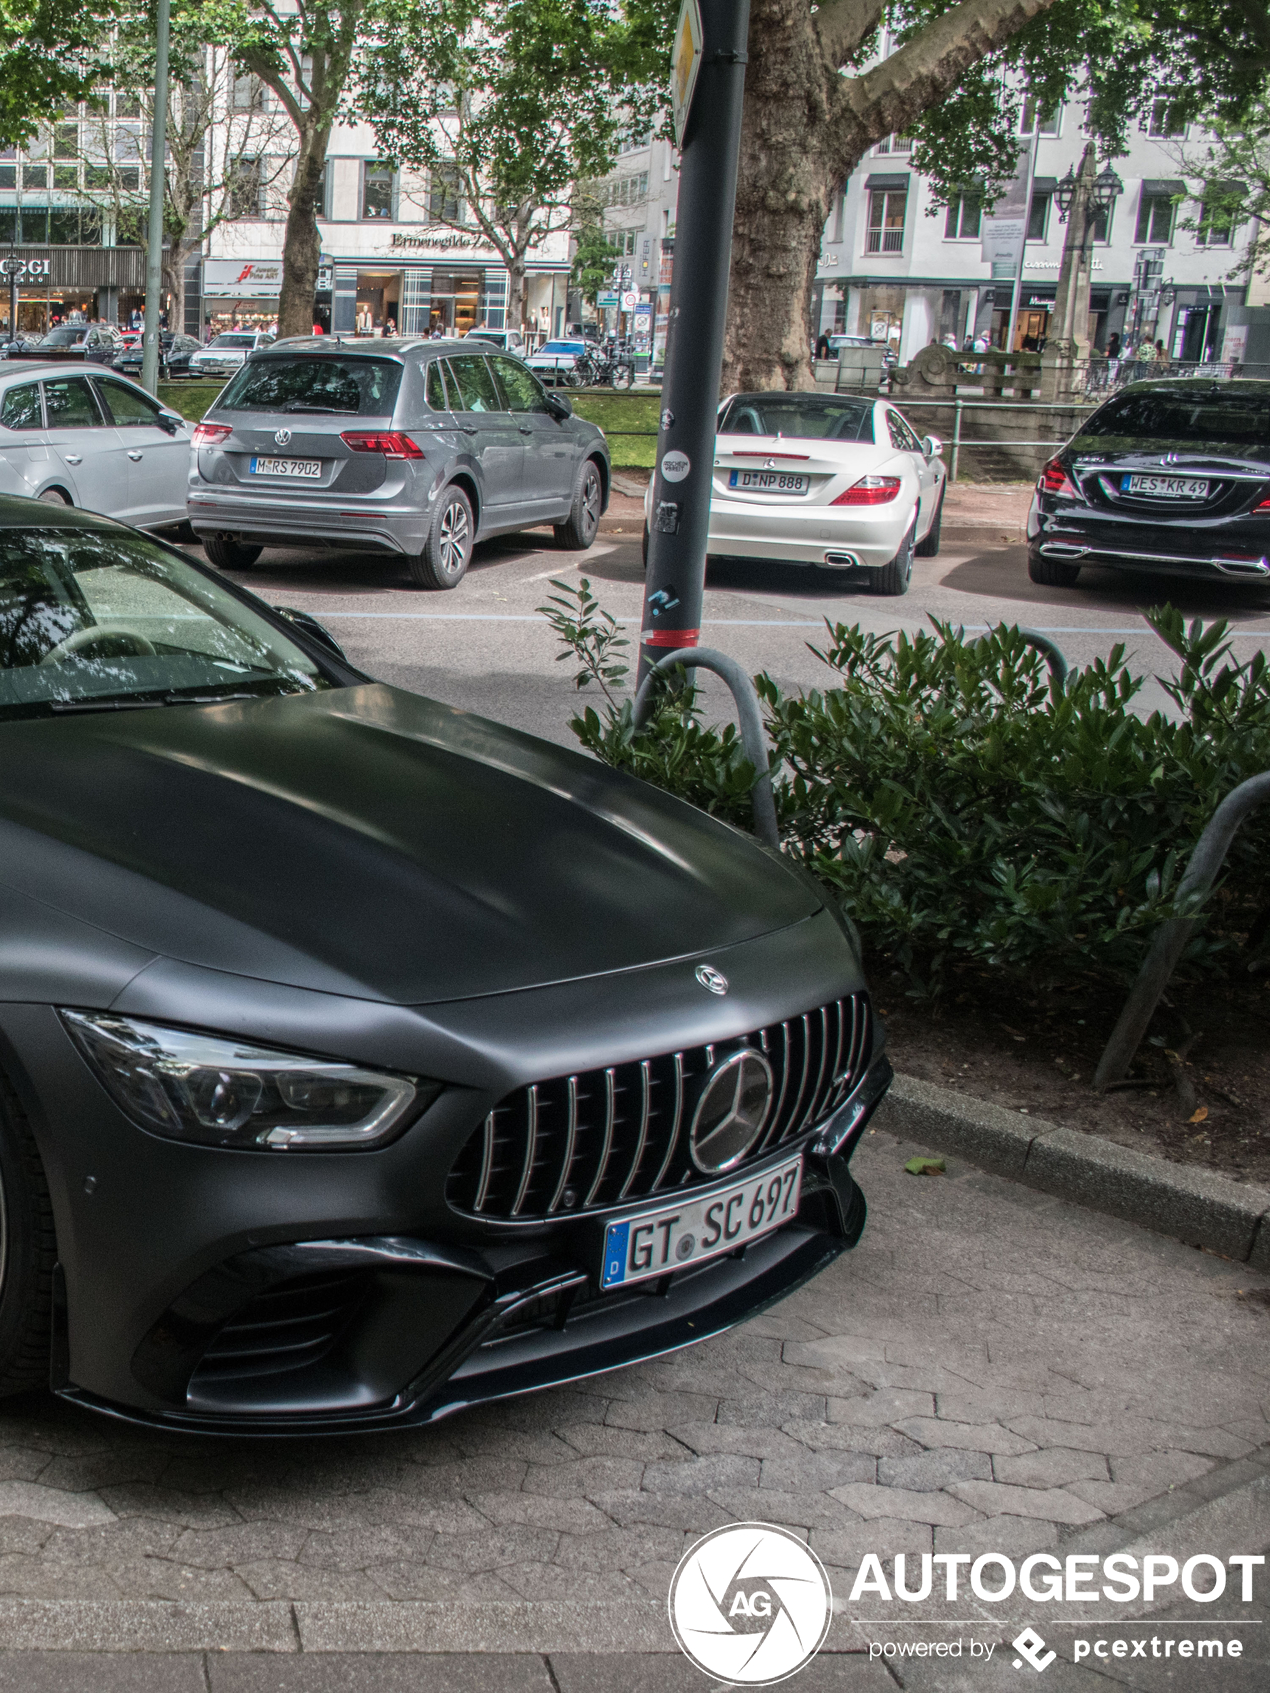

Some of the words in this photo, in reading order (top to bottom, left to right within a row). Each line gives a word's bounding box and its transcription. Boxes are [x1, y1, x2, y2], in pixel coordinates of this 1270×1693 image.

[256, 459, 266, 473] M
[272, 460, 288, 474] RS
[290, 462, 320, 476] 7902
[742, 473, 751, 486] D
[758, 474, 777, 488] NP
[778, 476, 803, 490] 888
[1131, 475, 1161, 491] WES
[1166, 480, 1185, 493] KR
[1188, 481, 1207, 495] 49
[610, 1261, 619, 1275] D
[627, 1214, 681, 1272] GT
[701, 1192, 744, 1249] SC
[748, 1166, 798, 1229] 697
